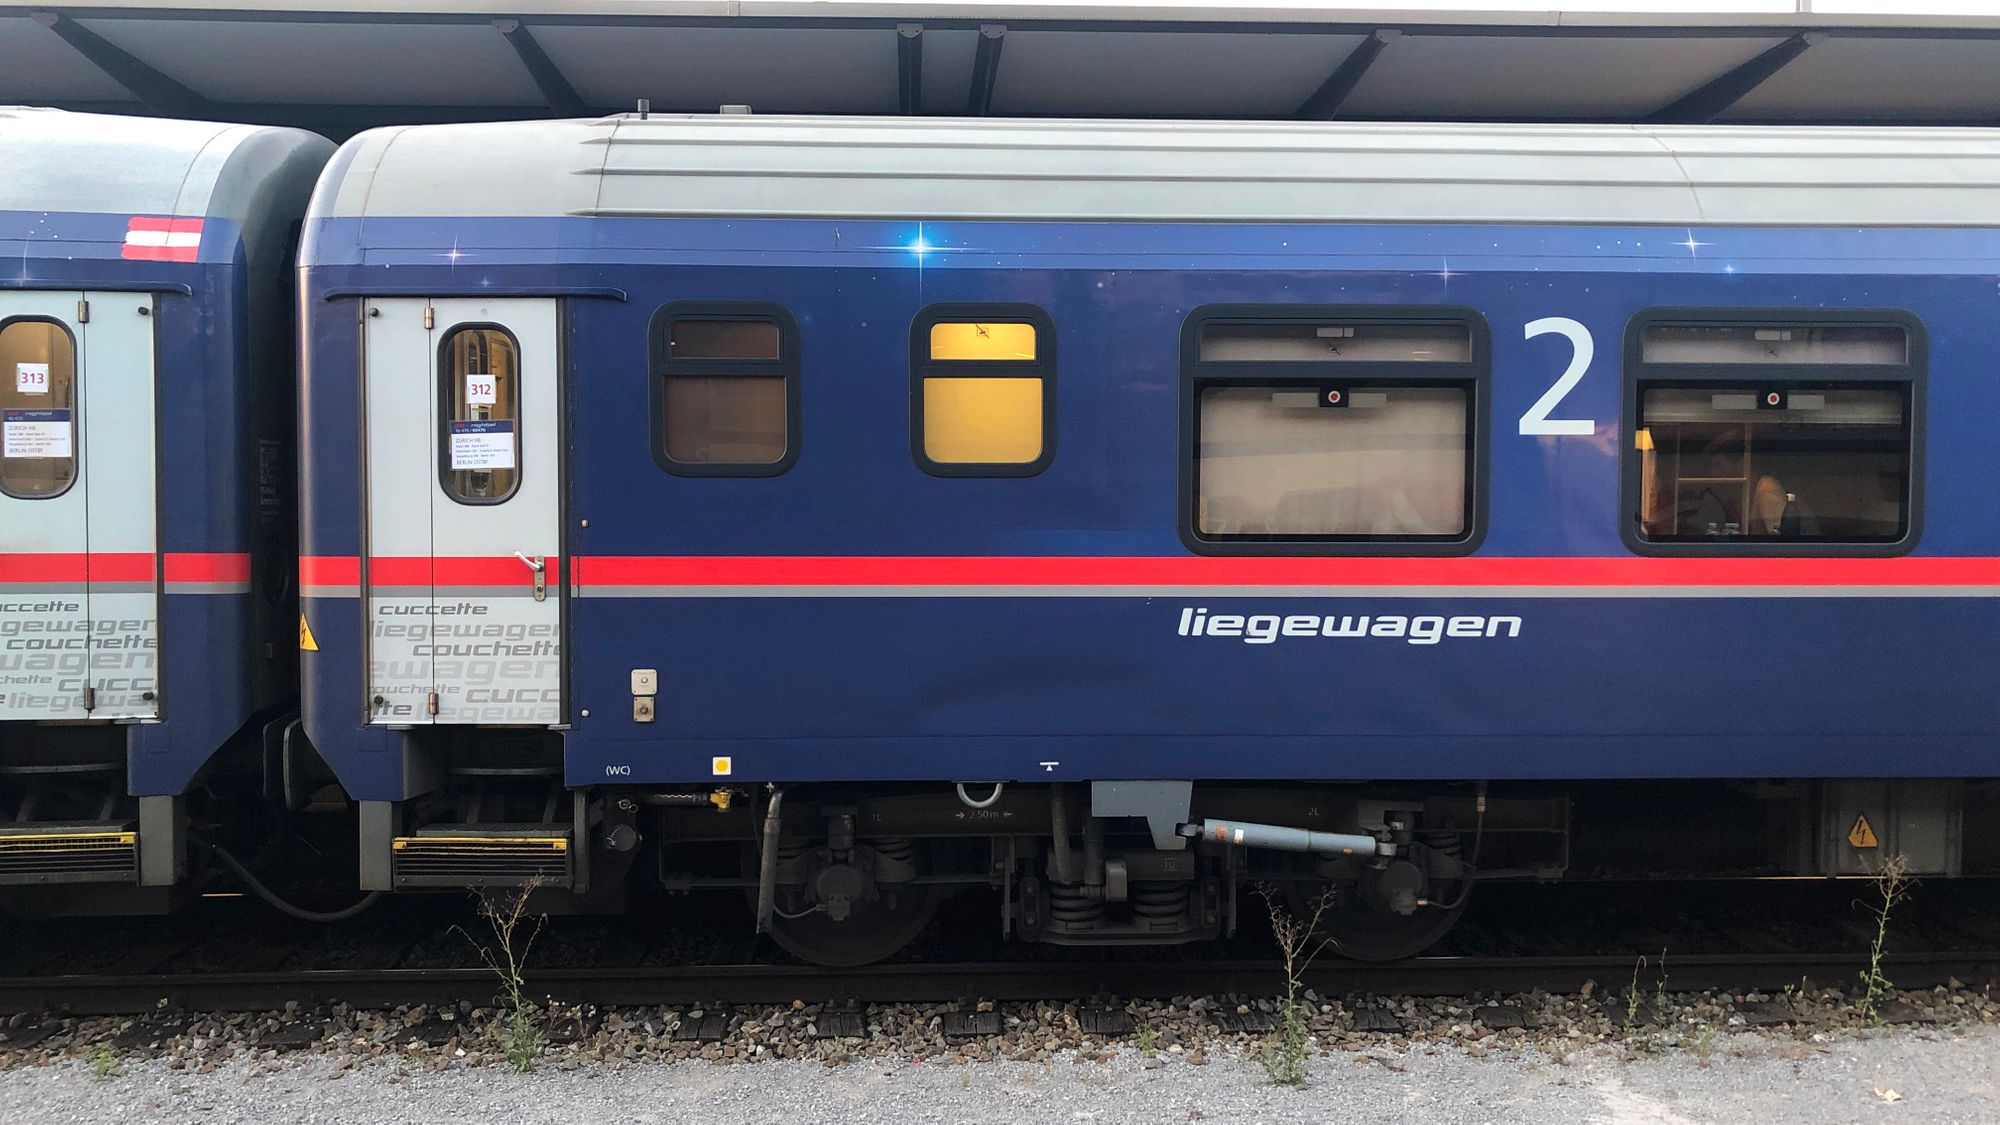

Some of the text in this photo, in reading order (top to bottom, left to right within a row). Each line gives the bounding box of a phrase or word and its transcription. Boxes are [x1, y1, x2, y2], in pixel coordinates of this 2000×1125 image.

[21, 373, 45, 384] 313
[1517, 316, 1595, 436] 2
[471, 384, 491, 395] 312
[0, 601, 79, 612] ccette
[379, 603, 488, 615] cuccette
[1178, 608, 1522, 645] liegewagen
[6, 635, 157, 650] couchette
[606, 766, 631, 777] (WC)
